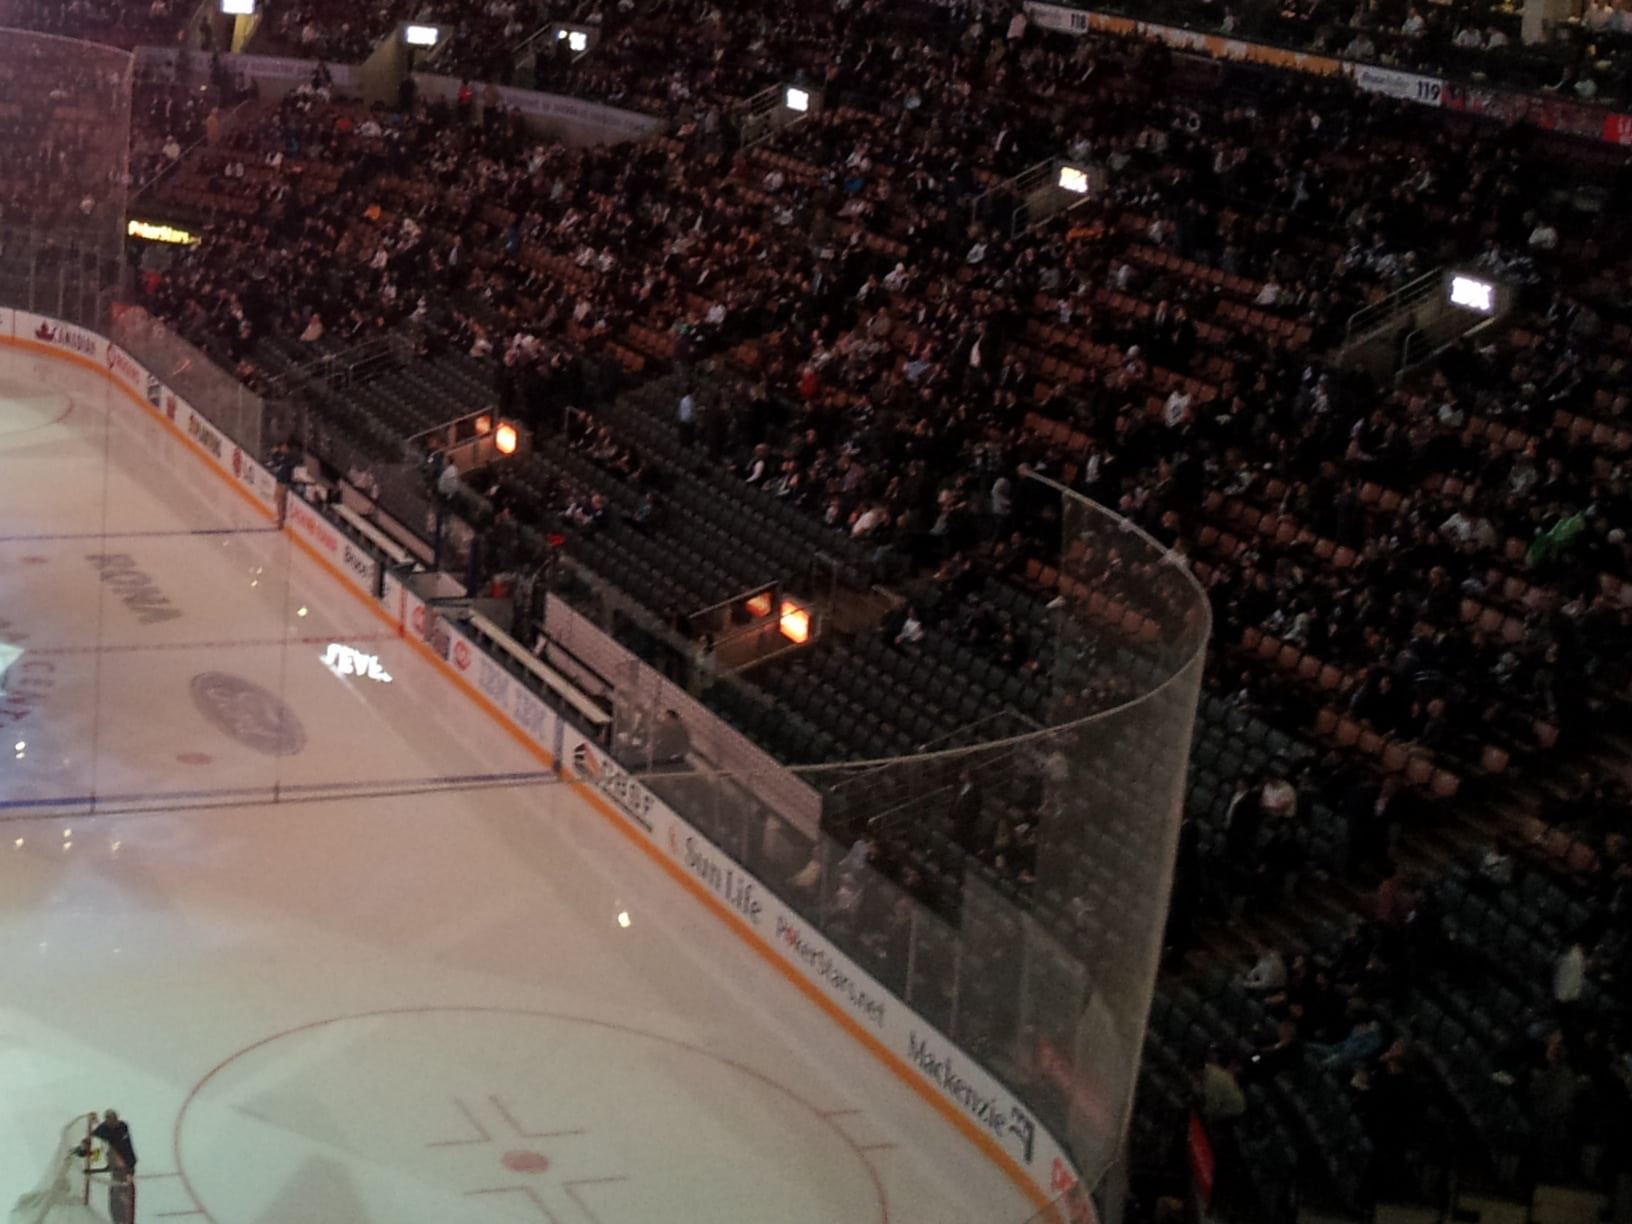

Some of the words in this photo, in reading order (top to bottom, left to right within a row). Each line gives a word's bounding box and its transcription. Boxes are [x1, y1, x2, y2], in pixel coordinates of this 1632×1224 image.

[1418, 80, 1441, 101] 119
[685, 836, 722, 891] Sun
[725, 870, 763, 925] Life
[908, 1030, 1008, 1137] Mackenzie
